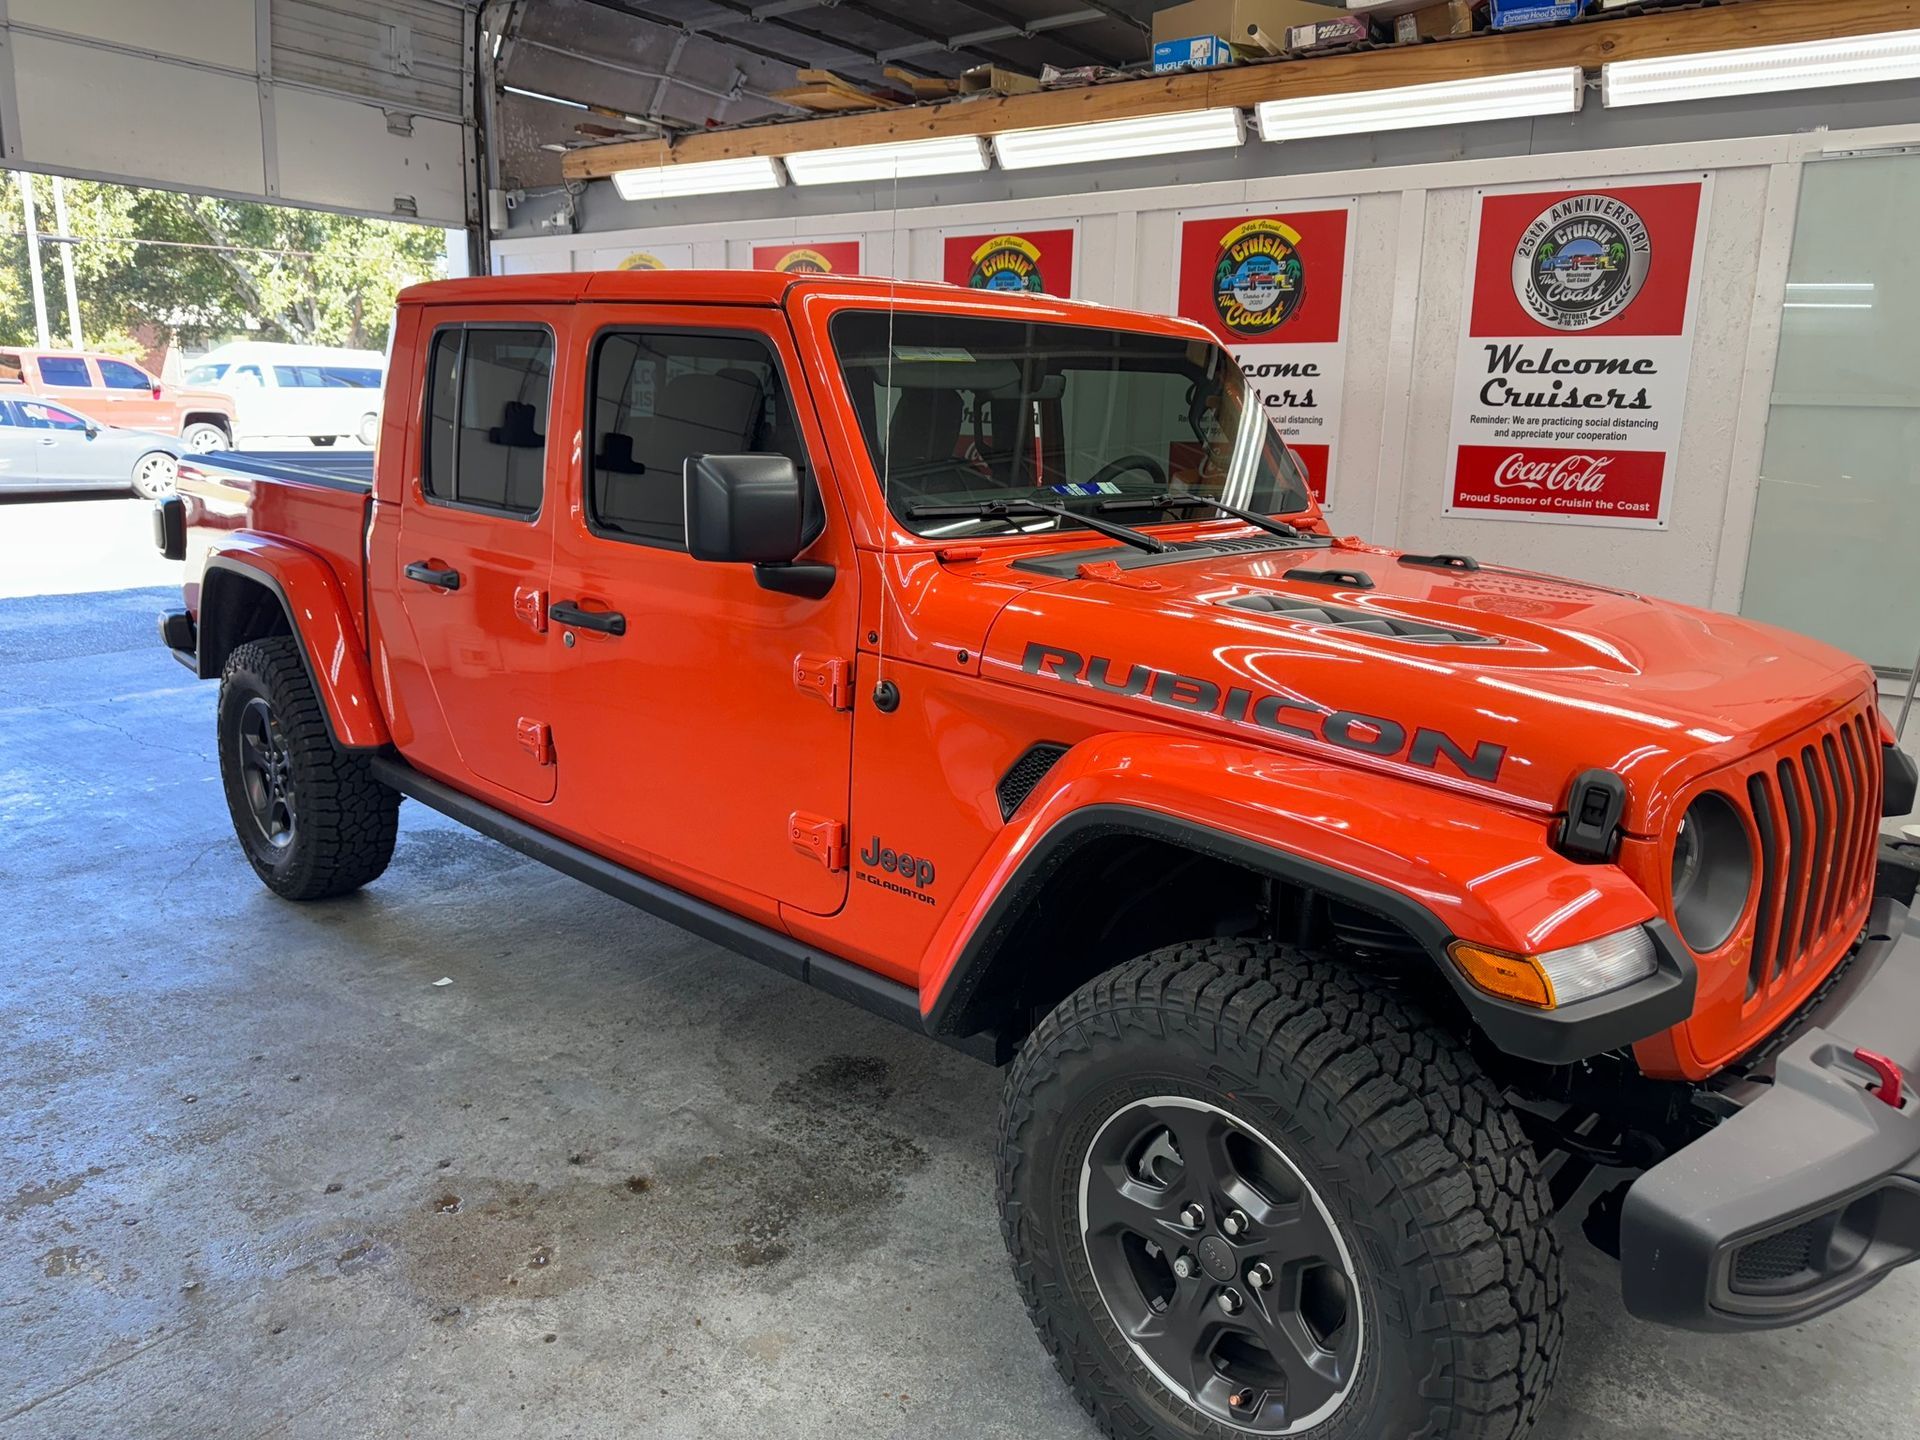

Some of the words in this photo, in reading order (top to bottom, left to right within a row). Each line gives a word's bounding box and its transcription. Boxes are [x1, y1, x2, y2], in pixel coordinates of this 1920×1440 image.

[1504, 13, 1529, 22] Chrome
[1531, 10, 1549, 18] Hood
[1550, 8, 1570, 17] Shield
[1518, 221, 1547, 258] 25th
[1551, 198, 1649, 253] ANNIVERSARY
[1554, 220, 1617, 245] Cruisin'
[1231, 234, 1292, 262] Cruisin'
[1539, 273, 1557, 285] The
[1546, 280, 1606, 302] Coast
[1218, 294, 1237, 307] The
[1226, 300, 1284, 326] Coast
[1235, 355, 1321, 377] come
[1484, 344, 1658, 374] Welcome
[1480, 377, 1652, 409] Cruisers
[1288, 415, 1323, 426] distancing
[1470, 414, 1510, 425] Reminder:
[1512, 416, 1525, 425] We
[1526, 418, 1540, 426] are
[1541, 416, 1583, 428] practicing
[1585, 417, 1611, 427] social
[1612, 418, 1659, 430] distancing
[1494, 429, 1509, 438] and
[1511, 429, 1553, 439] appreciate
[1554, 431, 1574, 440] your
[1576, 431, 1627, 442] cooperation
[1494, 453, 1615, 492] Coca-Cola
[1460, 492, 1490, 503] Proud
[1493, 494, 1536, 506] Sponsor
[1540, 496, 1551, 506] of
[1554, 498, 1595, 509] Cruisin'
[1595, 500, 1612, 510] the
[1617, 501, 1650, 511] Coast
[1022, 641, 1507, 783] RUBICON
[861, 836, 935, 888] Jeep
[867, 875, 936, 906] GLADIATOR
